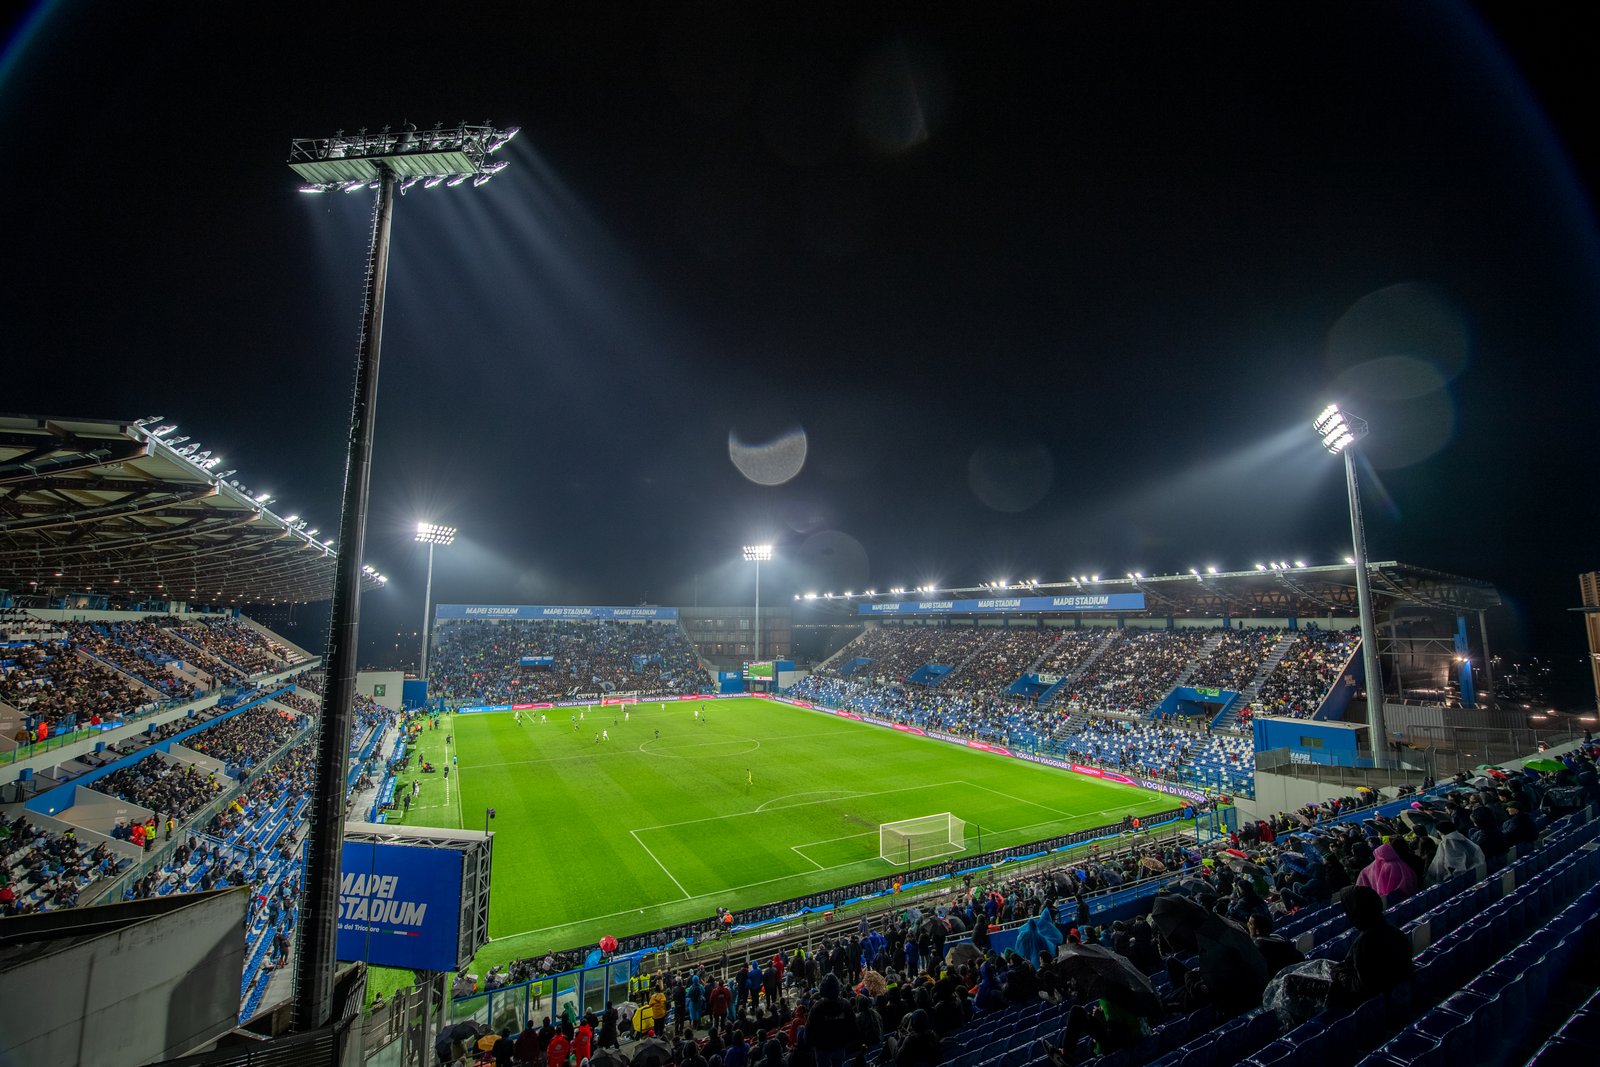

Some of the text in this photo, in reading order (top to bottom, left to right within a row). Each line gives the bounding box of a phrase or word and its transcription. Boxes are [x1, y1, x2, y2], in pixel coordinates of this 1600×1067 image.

[1053, 596, 1108, 606] MAPEI STADIUM
[1016, 752, 1034, 760] VOGLIA
[1040, 757, 1071, 769] VIAGGIARE?
[1141, 781, 1168, 792] VOGLIA
[340, 872, 398, 899] MAPEI
[338, 896, 427, 926] STADIUM
